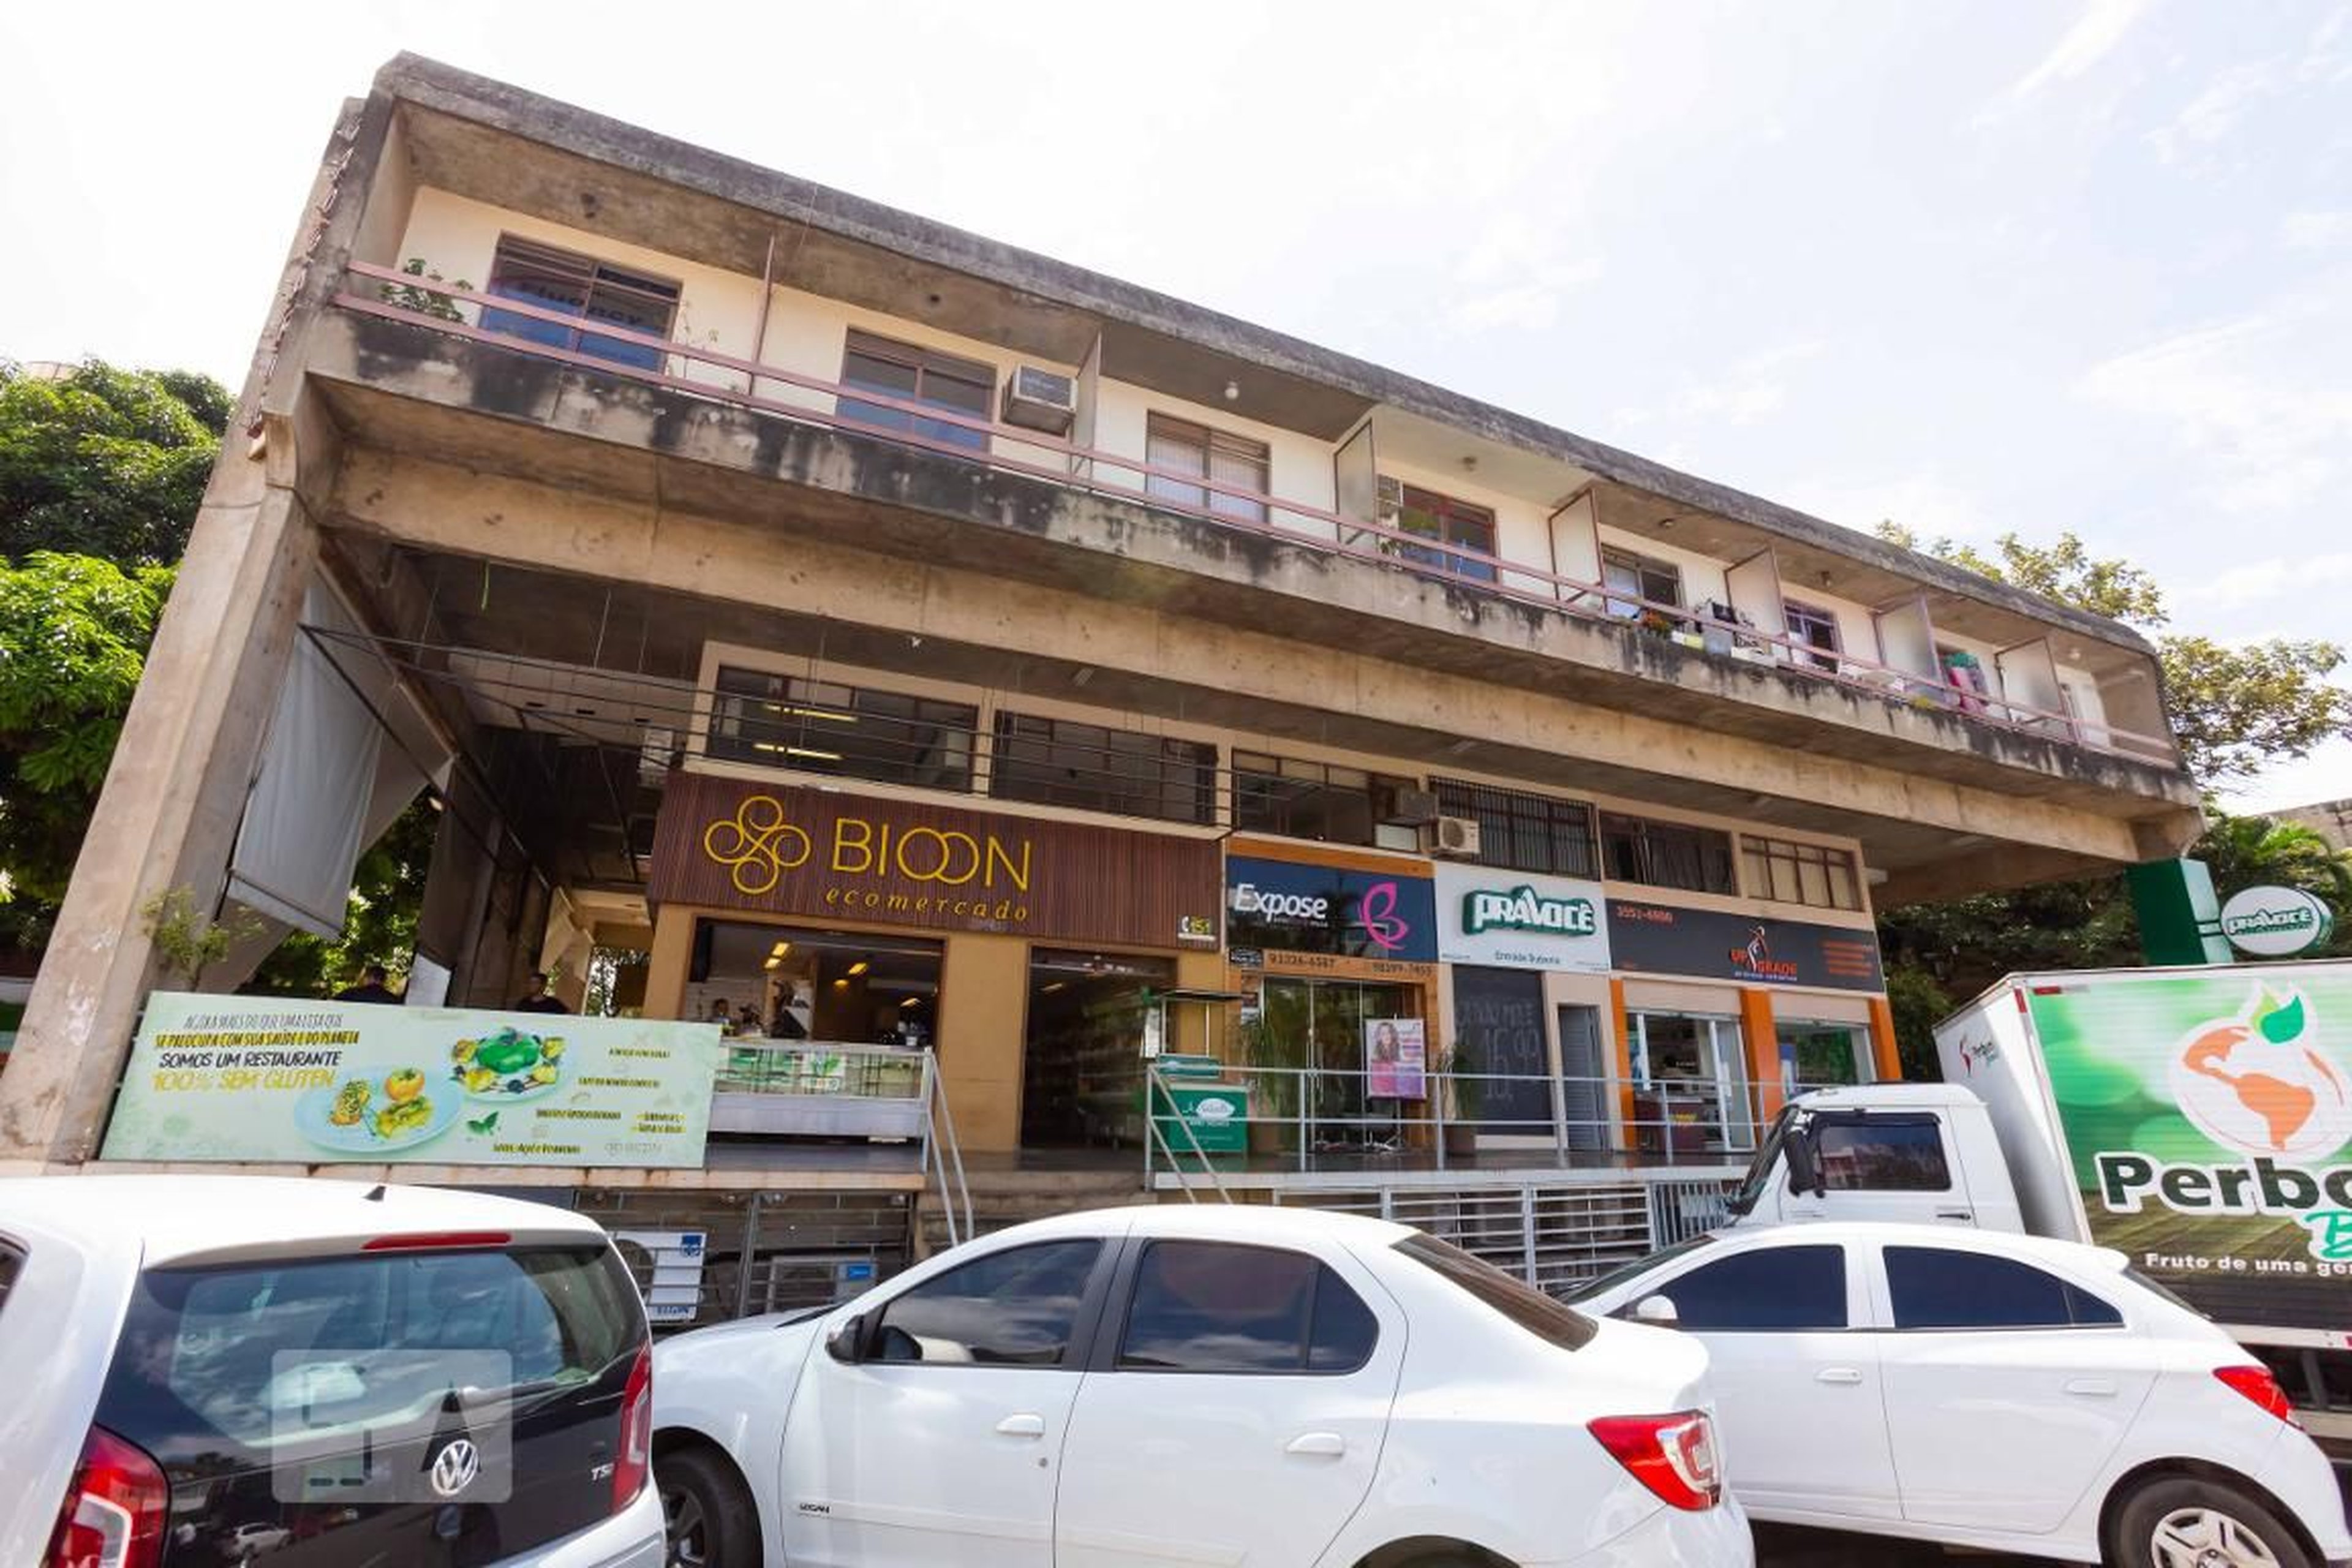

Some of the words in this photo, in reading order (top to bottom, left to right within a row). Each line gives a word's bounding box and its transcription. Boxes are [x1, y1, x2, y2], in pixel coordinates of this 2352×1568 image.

[832, 818, 1030, 890] BIOON
[826, 888, 1027, 919] ecomercado
[1234, 883, 1327, 922] Expose
[160, 1052, 213, 1068] SOMOS
[216, 1053, 241, 1068] UM
[244, 1051, 343, 1067] RESTAURANTE
[2145, 1253, 2209, 1268] Fruto
[2217, 1256, 2247, 1270] de
[2255, 1259, 2307, 1273] uma
